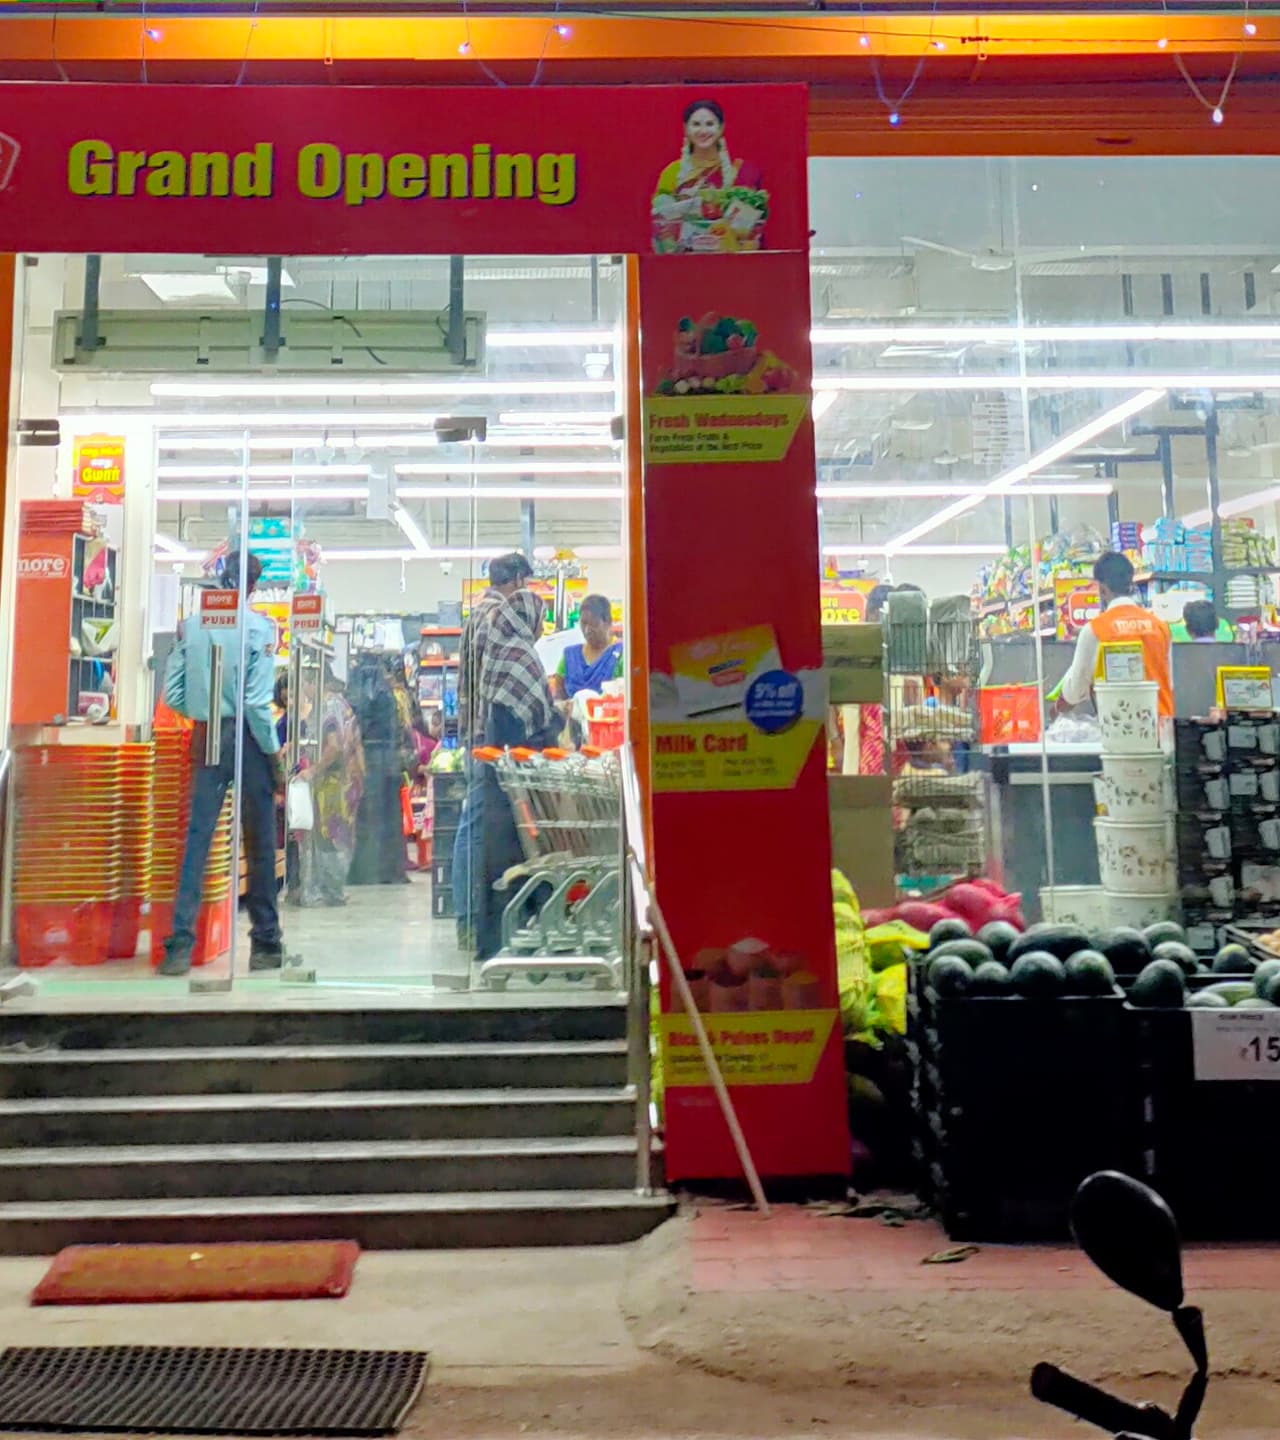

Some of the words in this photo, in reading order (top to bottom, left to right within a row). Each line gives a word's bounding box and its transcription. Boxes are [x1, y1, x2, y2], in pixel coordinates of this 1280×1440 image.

[67, 138, 275, 199] Grand
[297, 141, 579, 207] Opening
[648, 413, 690, 429] Fresh
[207, 594, 234, 606] more
[201, 615, 236, 625] PUSH
[822, 608, 861, 623] ore
[293, 619, 320, 629] PUSH
[655, 734, 697, 754] Milk
[703, 733, 749, 753] Card
